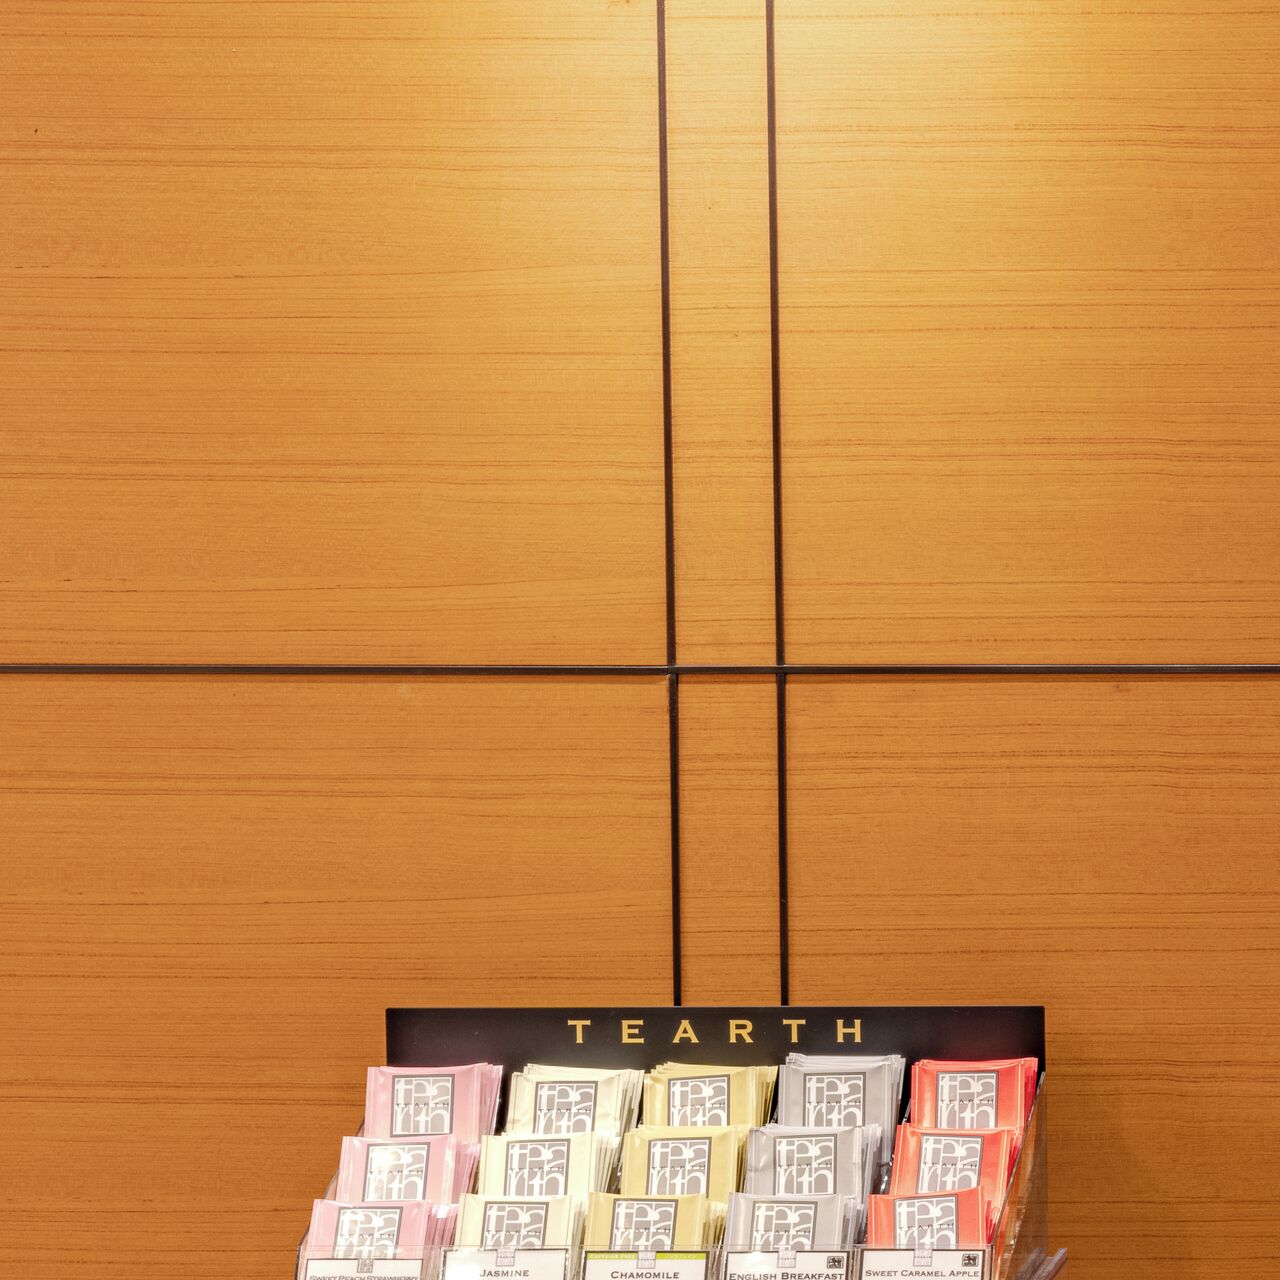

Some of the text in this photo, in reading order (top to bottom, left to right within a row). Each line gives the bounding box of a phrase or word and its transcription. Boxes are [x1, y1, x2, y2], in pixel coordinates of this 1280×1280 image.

[568, 1019, 862, 1044] TEARTH
[480, 1269, 529, 1277] JASMINE
[611, 1271, 680, 1279] CHAMOMILE
[729, 1272, 844, 1280] ENGLISH BREAKFAST
[865, 1269, 980, 1278] SWEET CARAMEL APPLE
